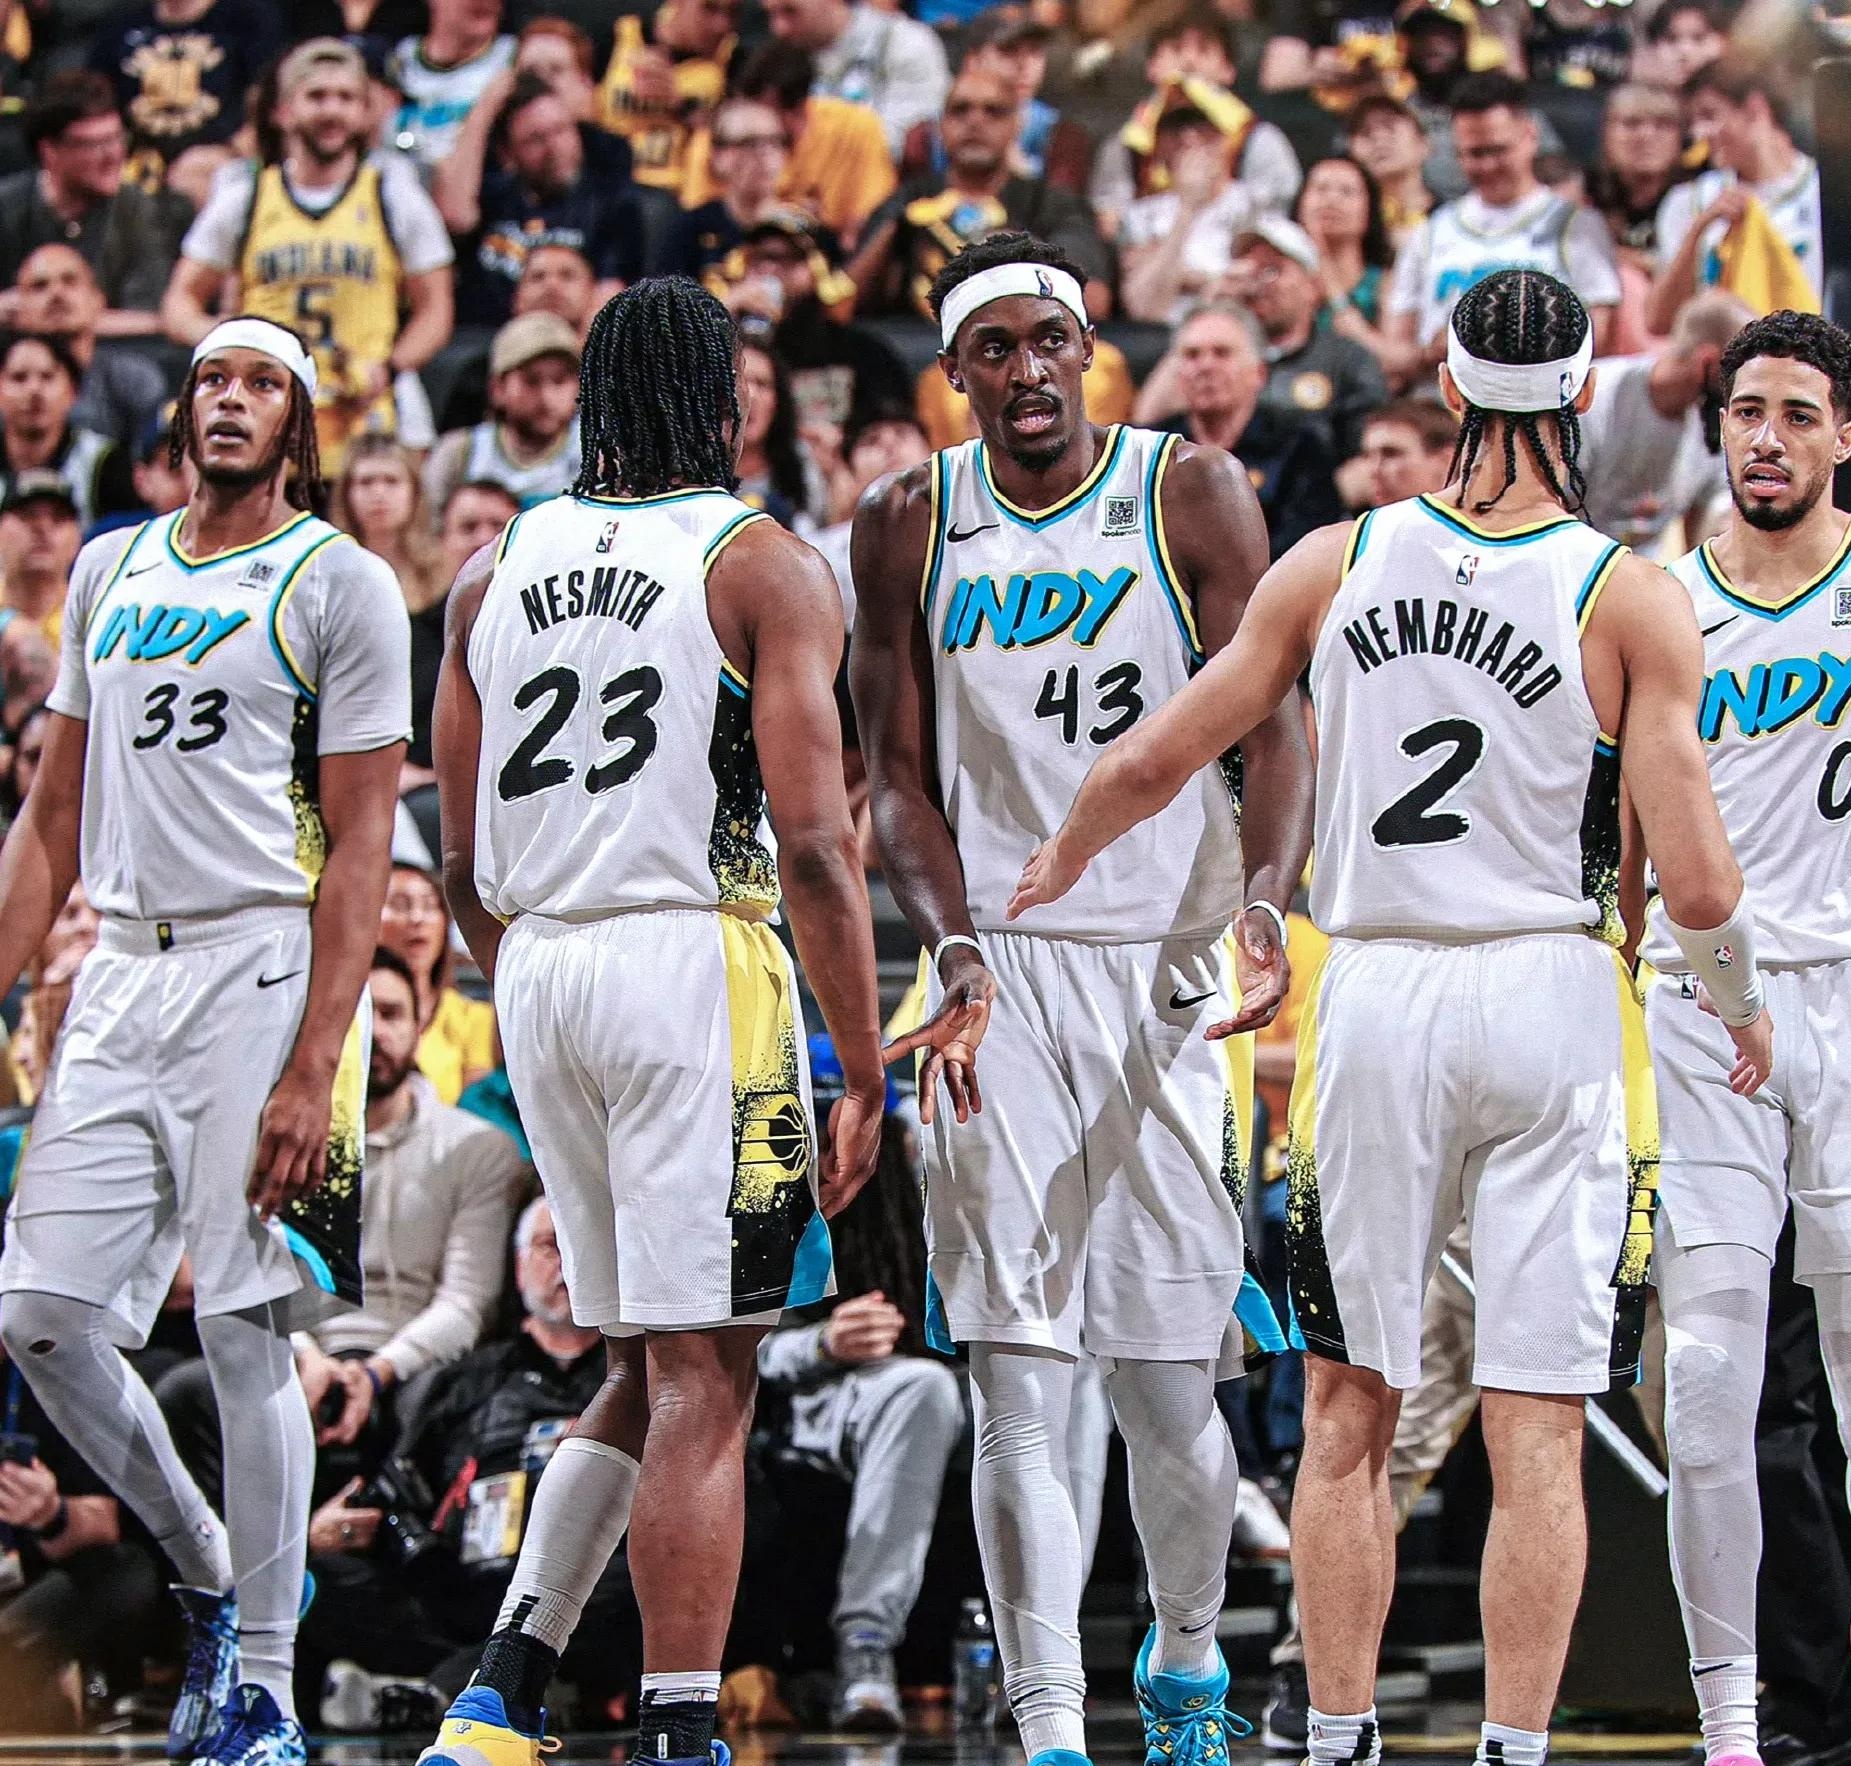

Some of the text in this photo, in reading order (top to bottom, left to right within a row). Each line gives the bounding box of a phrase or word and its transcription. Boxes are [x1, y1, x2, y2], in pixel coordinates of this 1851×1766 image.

[93, 603, 252, 668] INDY
[520, 567, 665, 635] NESMITH
[942, 566, 1141, 657] INDY
[1342, 598, 1562, 709] NEMBHARD
[1696, 651, 1851, 743] NDY
[133, 683, 229, 751] 33
[498, 665, 663, 801] 23
[1033, 661, 1144, 745] 43
[1371, 718, 1483, 847] 2
